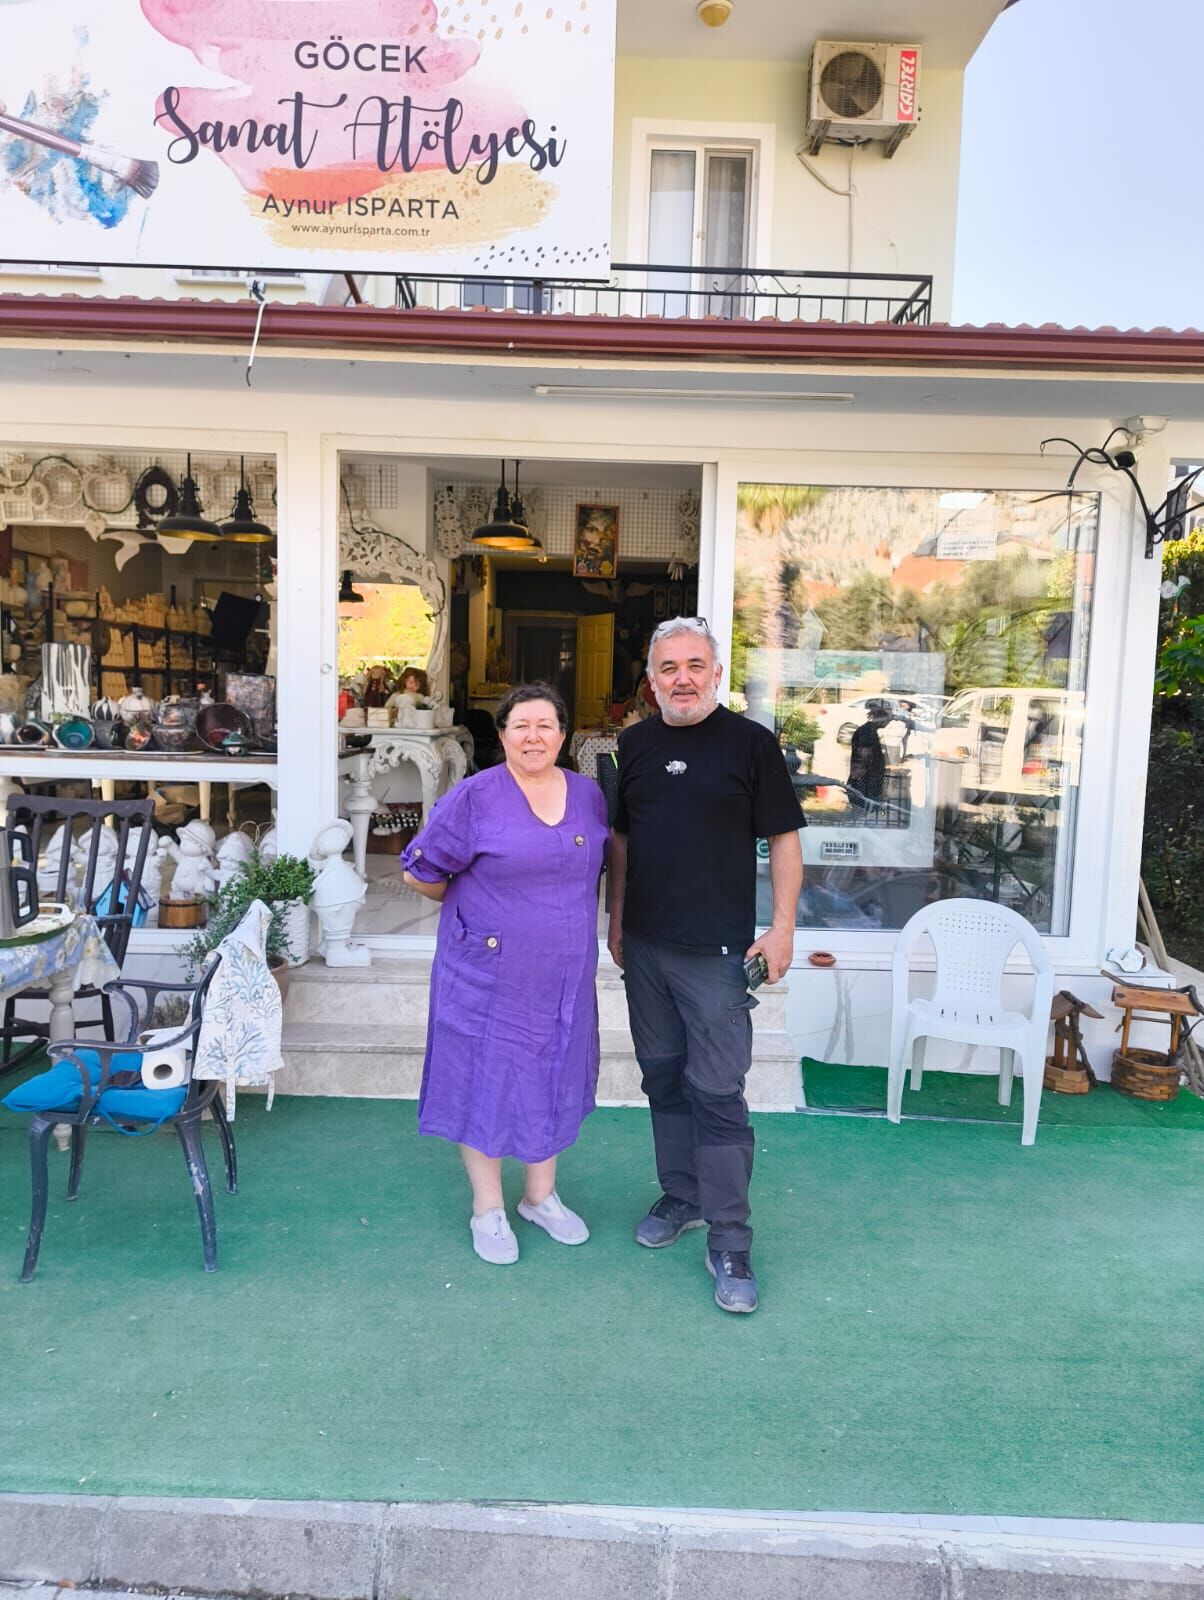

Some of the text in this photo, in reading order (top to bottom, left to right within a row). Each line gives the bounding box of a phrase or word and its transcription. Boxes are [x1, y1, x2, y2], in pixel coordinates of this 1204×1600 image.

[294, 36, 428, 74] GÖCEK
[899, 56, 916, 116] CARTEL
[153, 86, 567, 185] Sanat Atölyesi
[262, 193, 460, 219] Aynur ISPARTA
[291, 223, 431, 237] www.aynurisparta.com.tr
